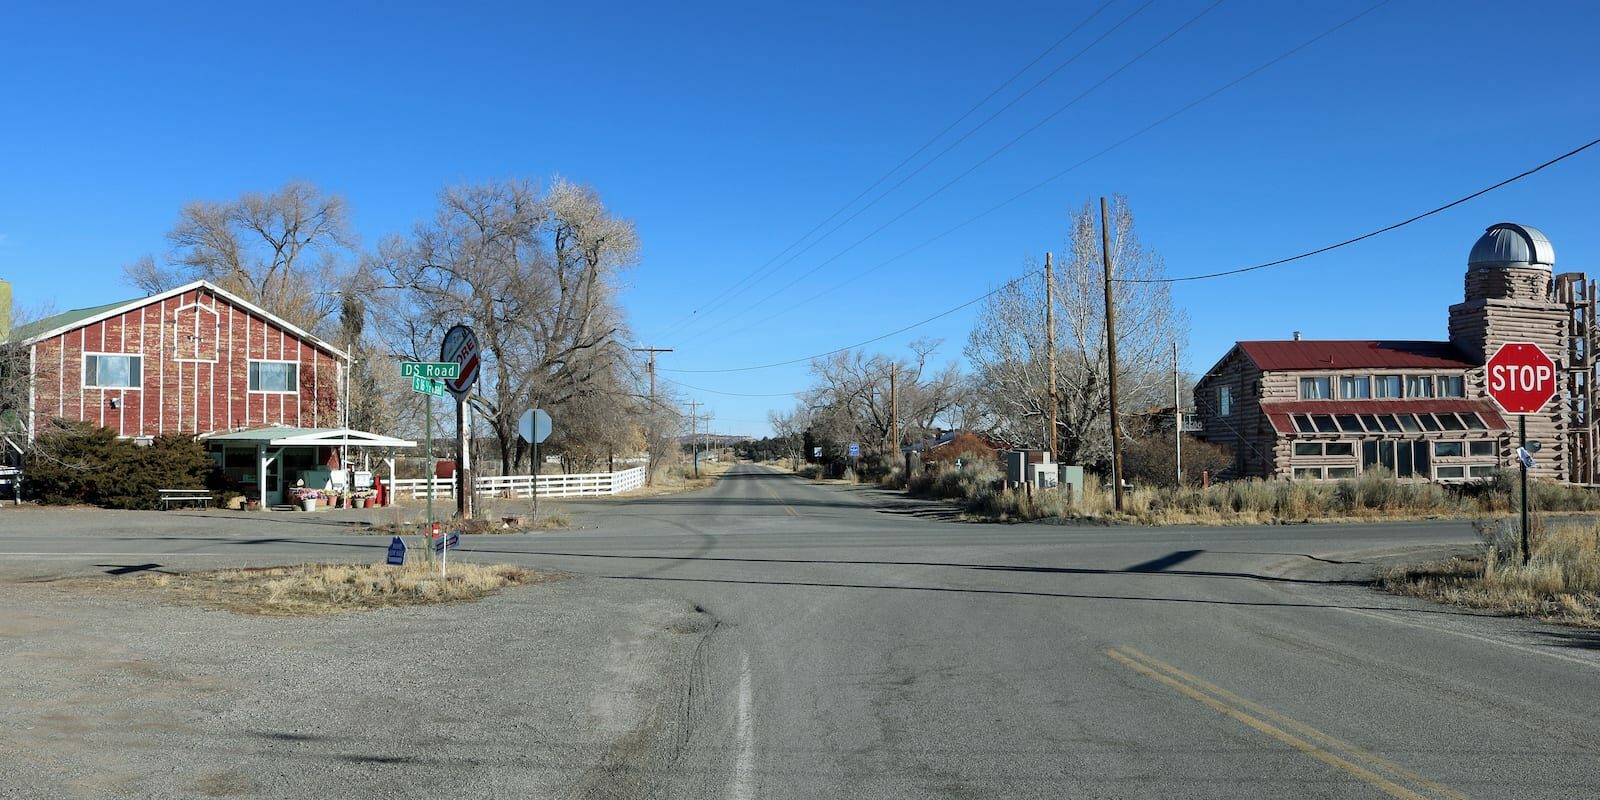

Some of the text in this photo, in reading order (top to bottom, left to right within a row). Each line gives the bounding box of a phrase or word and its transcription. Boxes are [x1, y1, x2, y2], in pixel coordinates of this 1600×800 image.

[456, 338, 475, 365] ORE
[405, 365, 455, 377] DS Road
[1491, 365, 1551, 392] STOP
